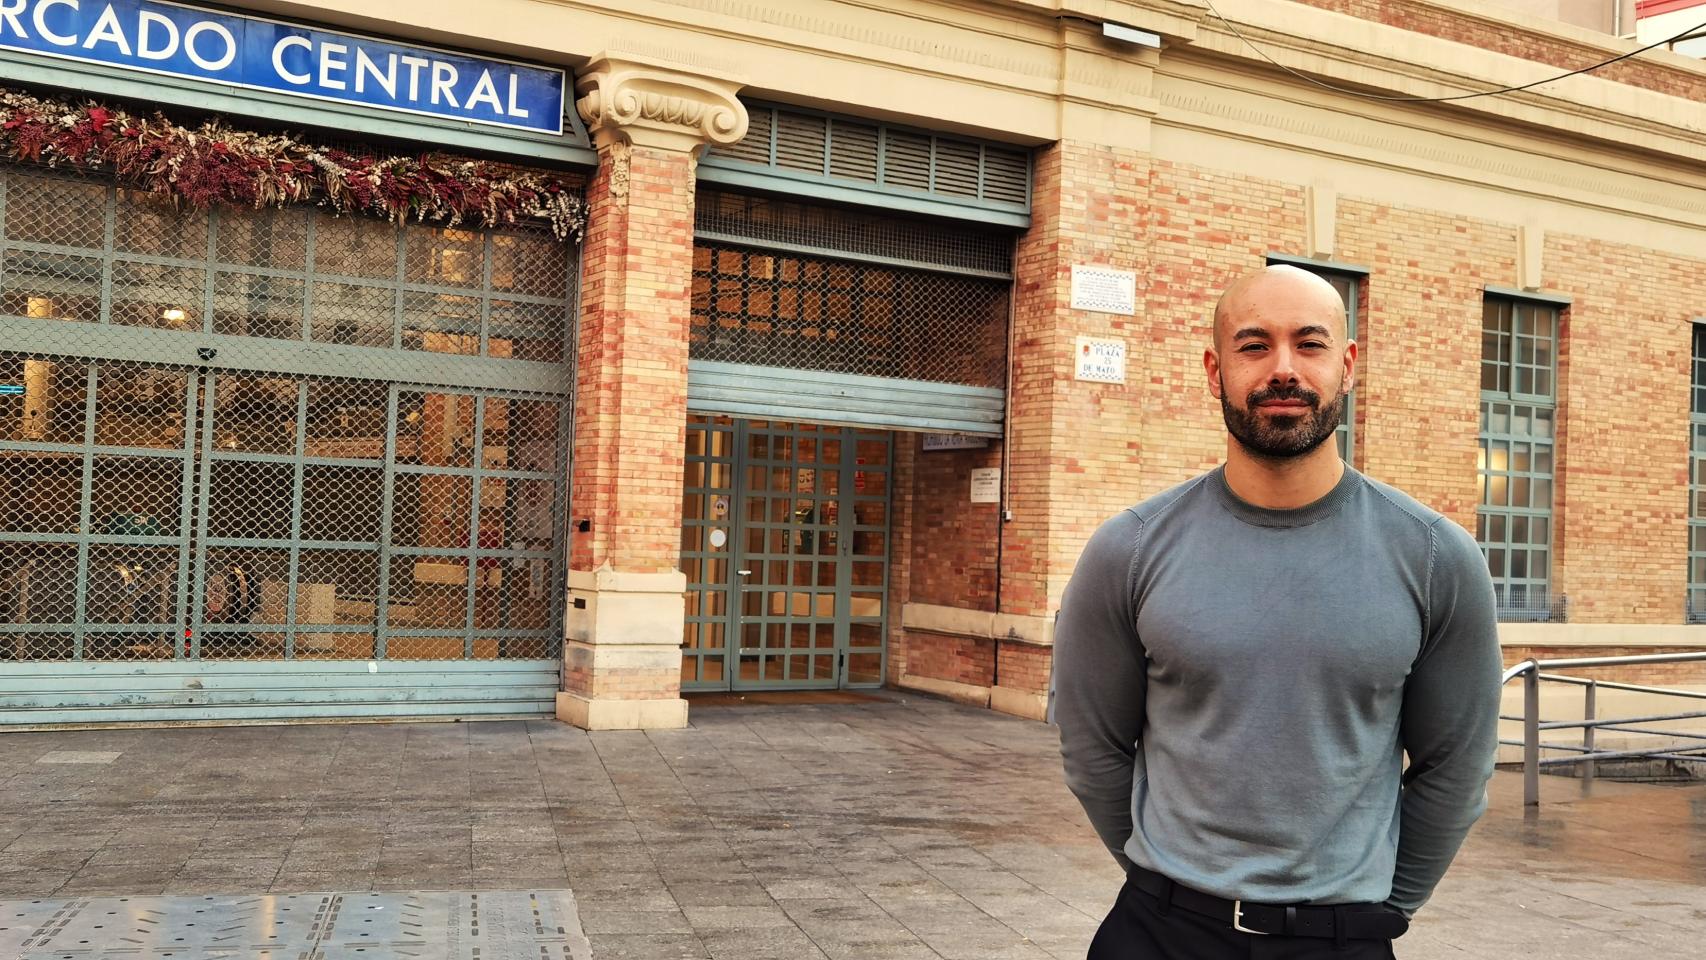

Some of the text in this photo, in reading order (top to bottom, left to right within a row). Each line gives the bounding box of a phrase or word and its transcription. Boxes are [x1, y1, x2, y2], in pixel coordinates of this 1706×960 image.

[272, 36, 529, 118] CENTRAL
[1095, 346, 1120, 358] PLAZA
[1103, 357, 1112, 365] 25
[1083, 363, 1115, 374] DE MAYO
